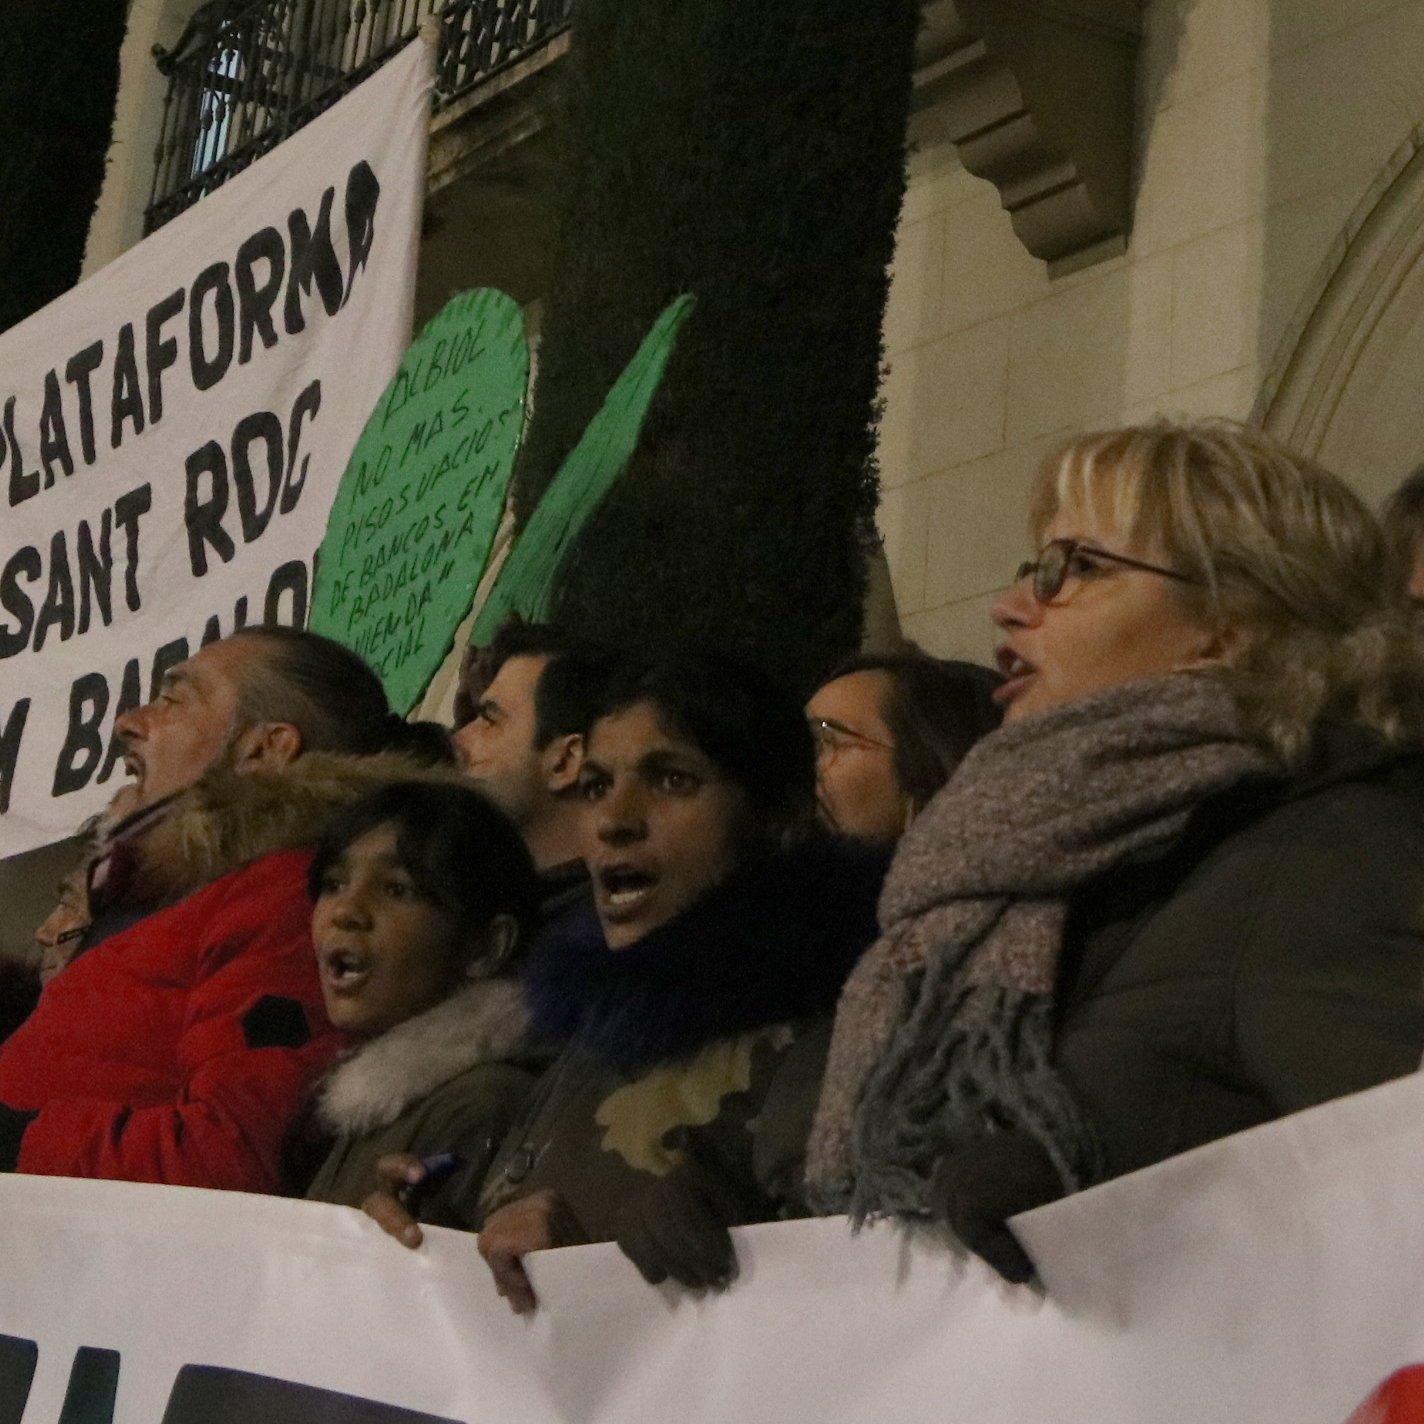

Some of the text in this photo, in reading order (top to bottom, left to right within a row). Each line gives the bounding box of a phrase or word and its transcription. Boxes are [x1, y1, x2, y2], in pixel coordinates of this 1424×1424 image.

[184, 379, 322, 577] ROC
[339, 483, 412, 567] PISOS
[348, 444, 393, 515] NO
[359, 502, 447, 588] BANCOS
[457, 459, 500, 512] EN
[346, 511, 475, 632] BADALONA
